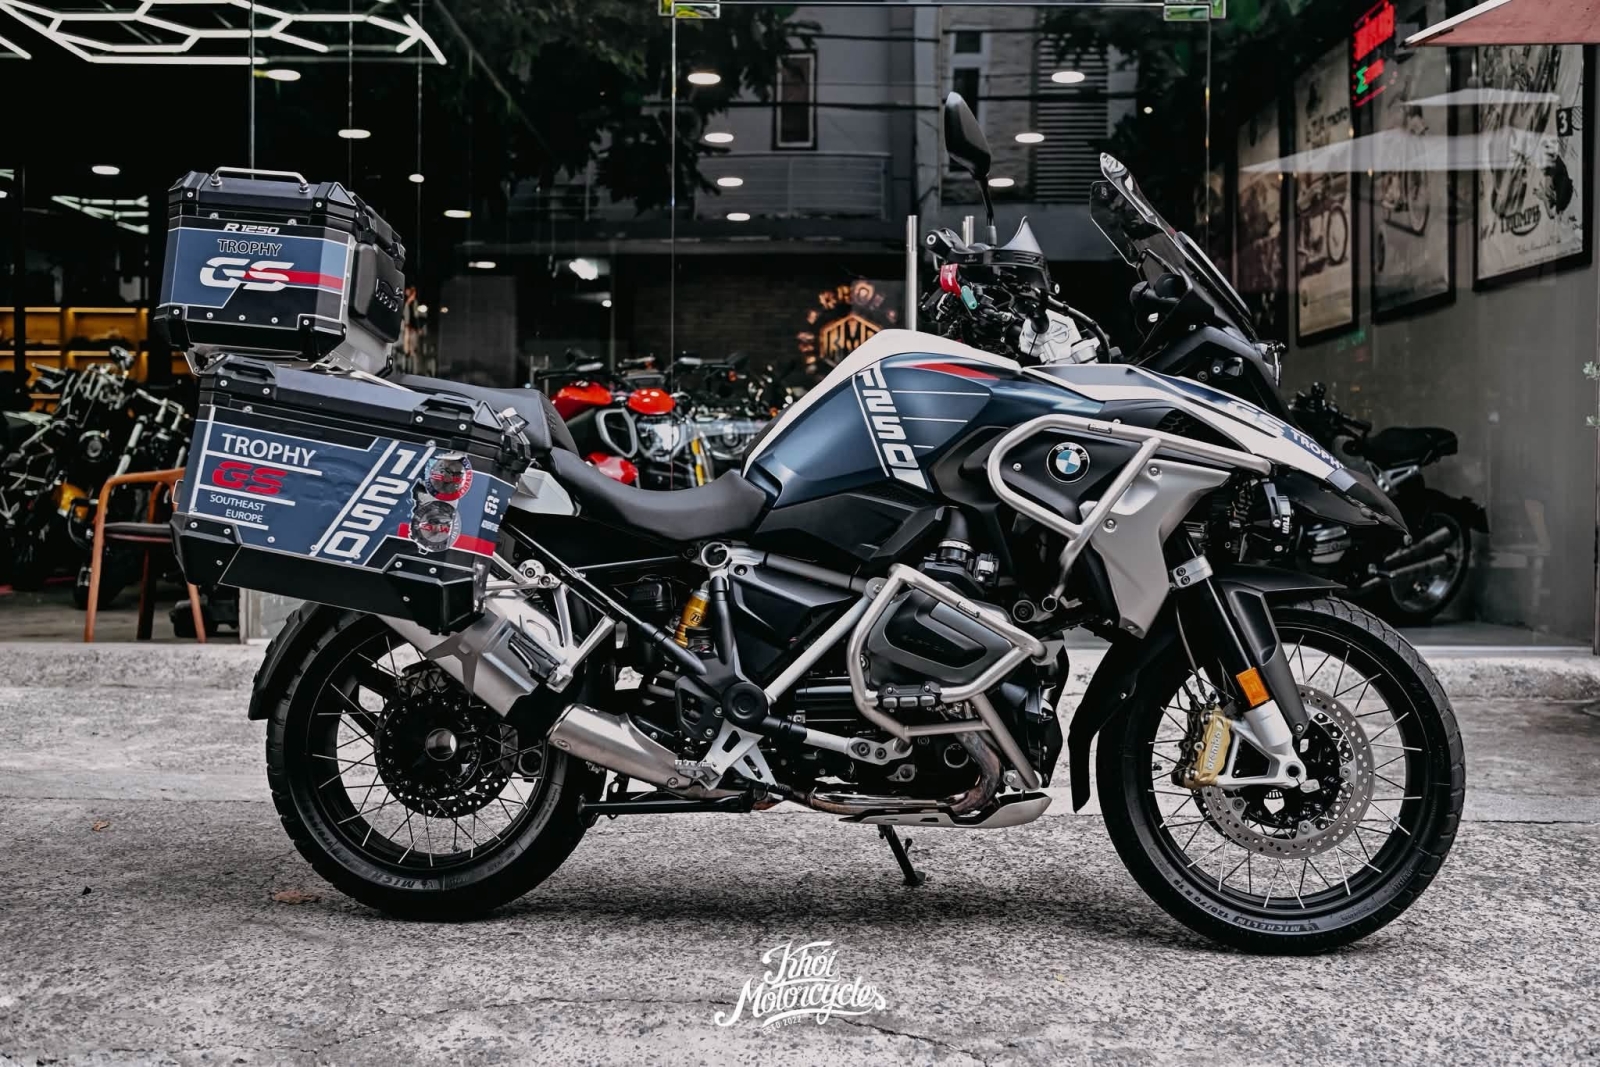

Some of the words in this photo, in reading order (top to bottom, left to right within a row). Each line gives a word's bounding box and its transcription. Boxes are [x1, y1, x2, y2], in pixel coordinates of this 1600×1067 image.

[1558, 110, 1568, 134] 3
[217, 238, 283, 257] TROPHY
[199, 256, 295, 292] GS
[221, 432, 317, 468] TROPHY
[211, 460, 288, 495] GS
[209, 493, 267, 513] SOUTHEAST
[324, 447, 416, 560] 1250
[225, 508, 263, 524] EUROPE
[1205, 730, 1223, 771] brembo
[1194, 896, 1229, 919] 120/70
[1237, 917, 1301, 932] MICHELIN
